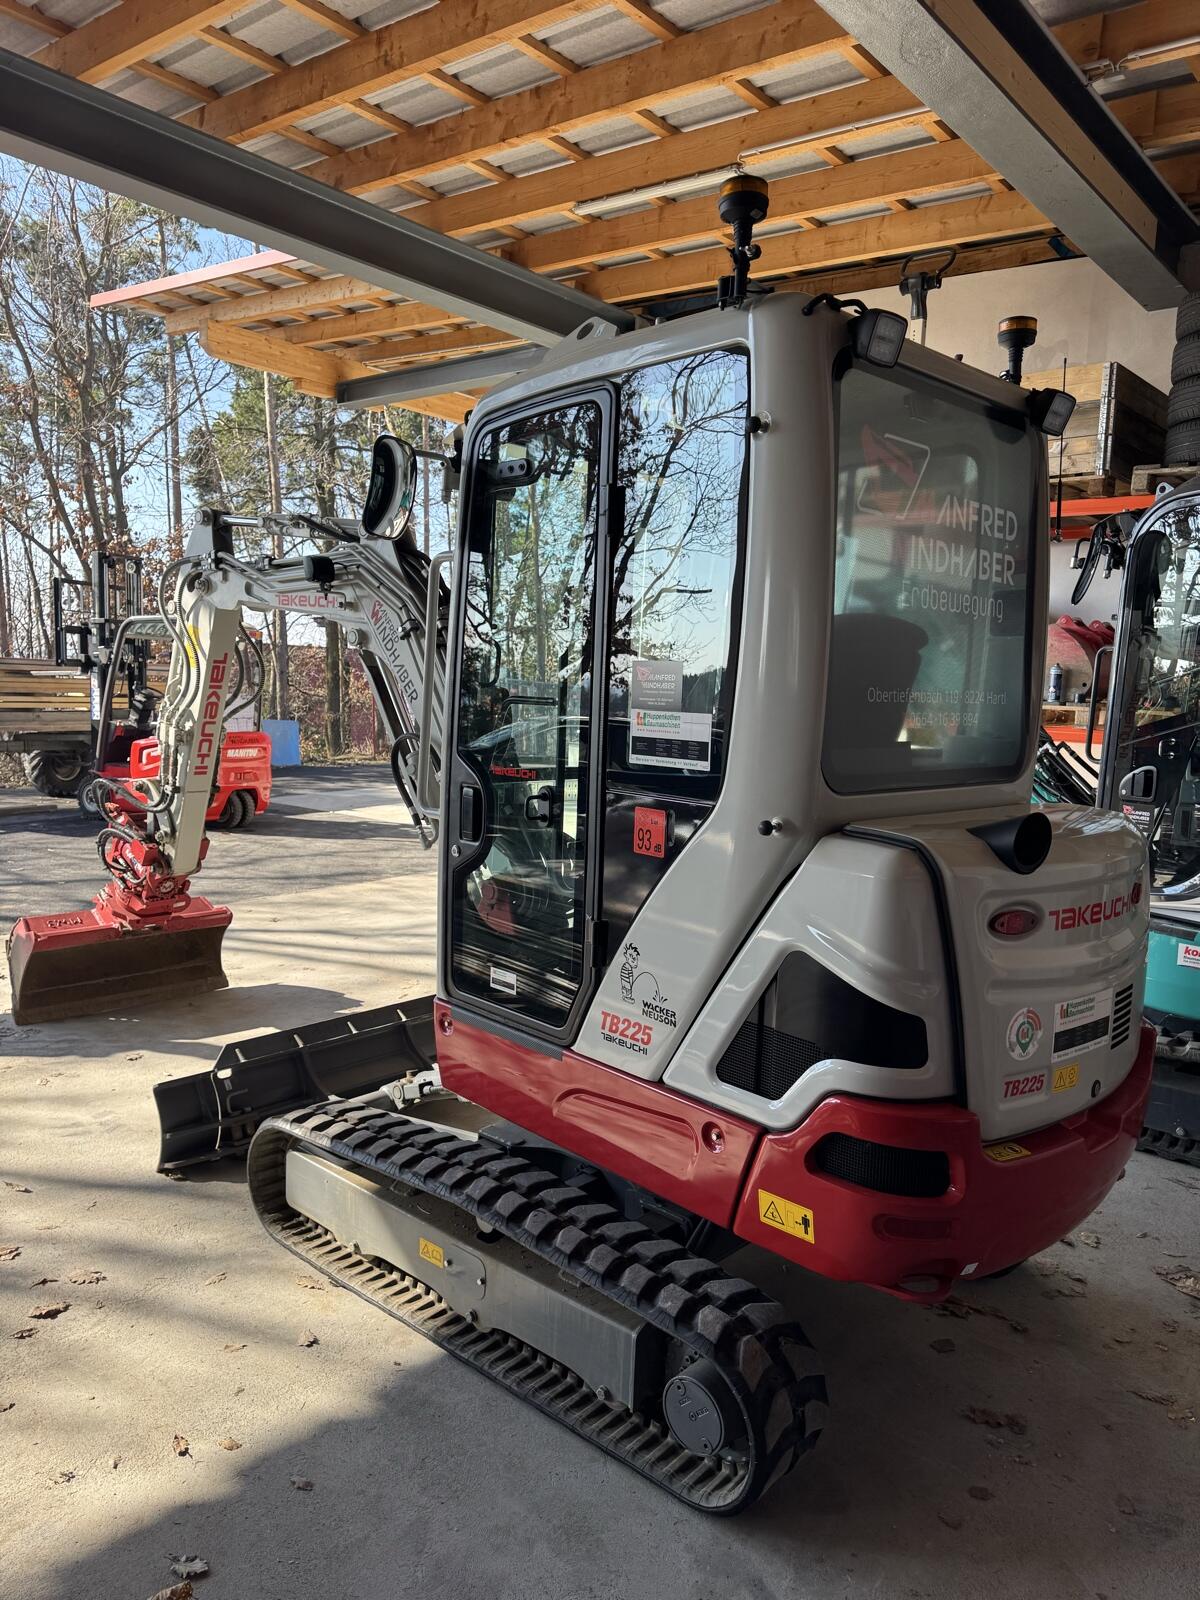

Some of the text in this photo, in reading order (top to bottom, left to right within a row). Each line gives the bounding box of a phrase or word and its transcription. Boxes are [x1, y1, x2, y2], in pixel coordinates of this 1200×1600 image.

[901, 580, 1004, 623] Erdbewegung
[867, 687, 942, 704] Obertiefenbach
[193, 652, 229, 776] TAKEUCHI
[226, 747, 259, 758] MANITOU
[637, 827, 662, 853] 93 dB
[641, 1008, 677, 1028] NEUSON
[642, 999, 677, 1020] WACKER
[601, 1010, 653, 1046] TB225
[1003, 1073, 1045, 1099] TB225
